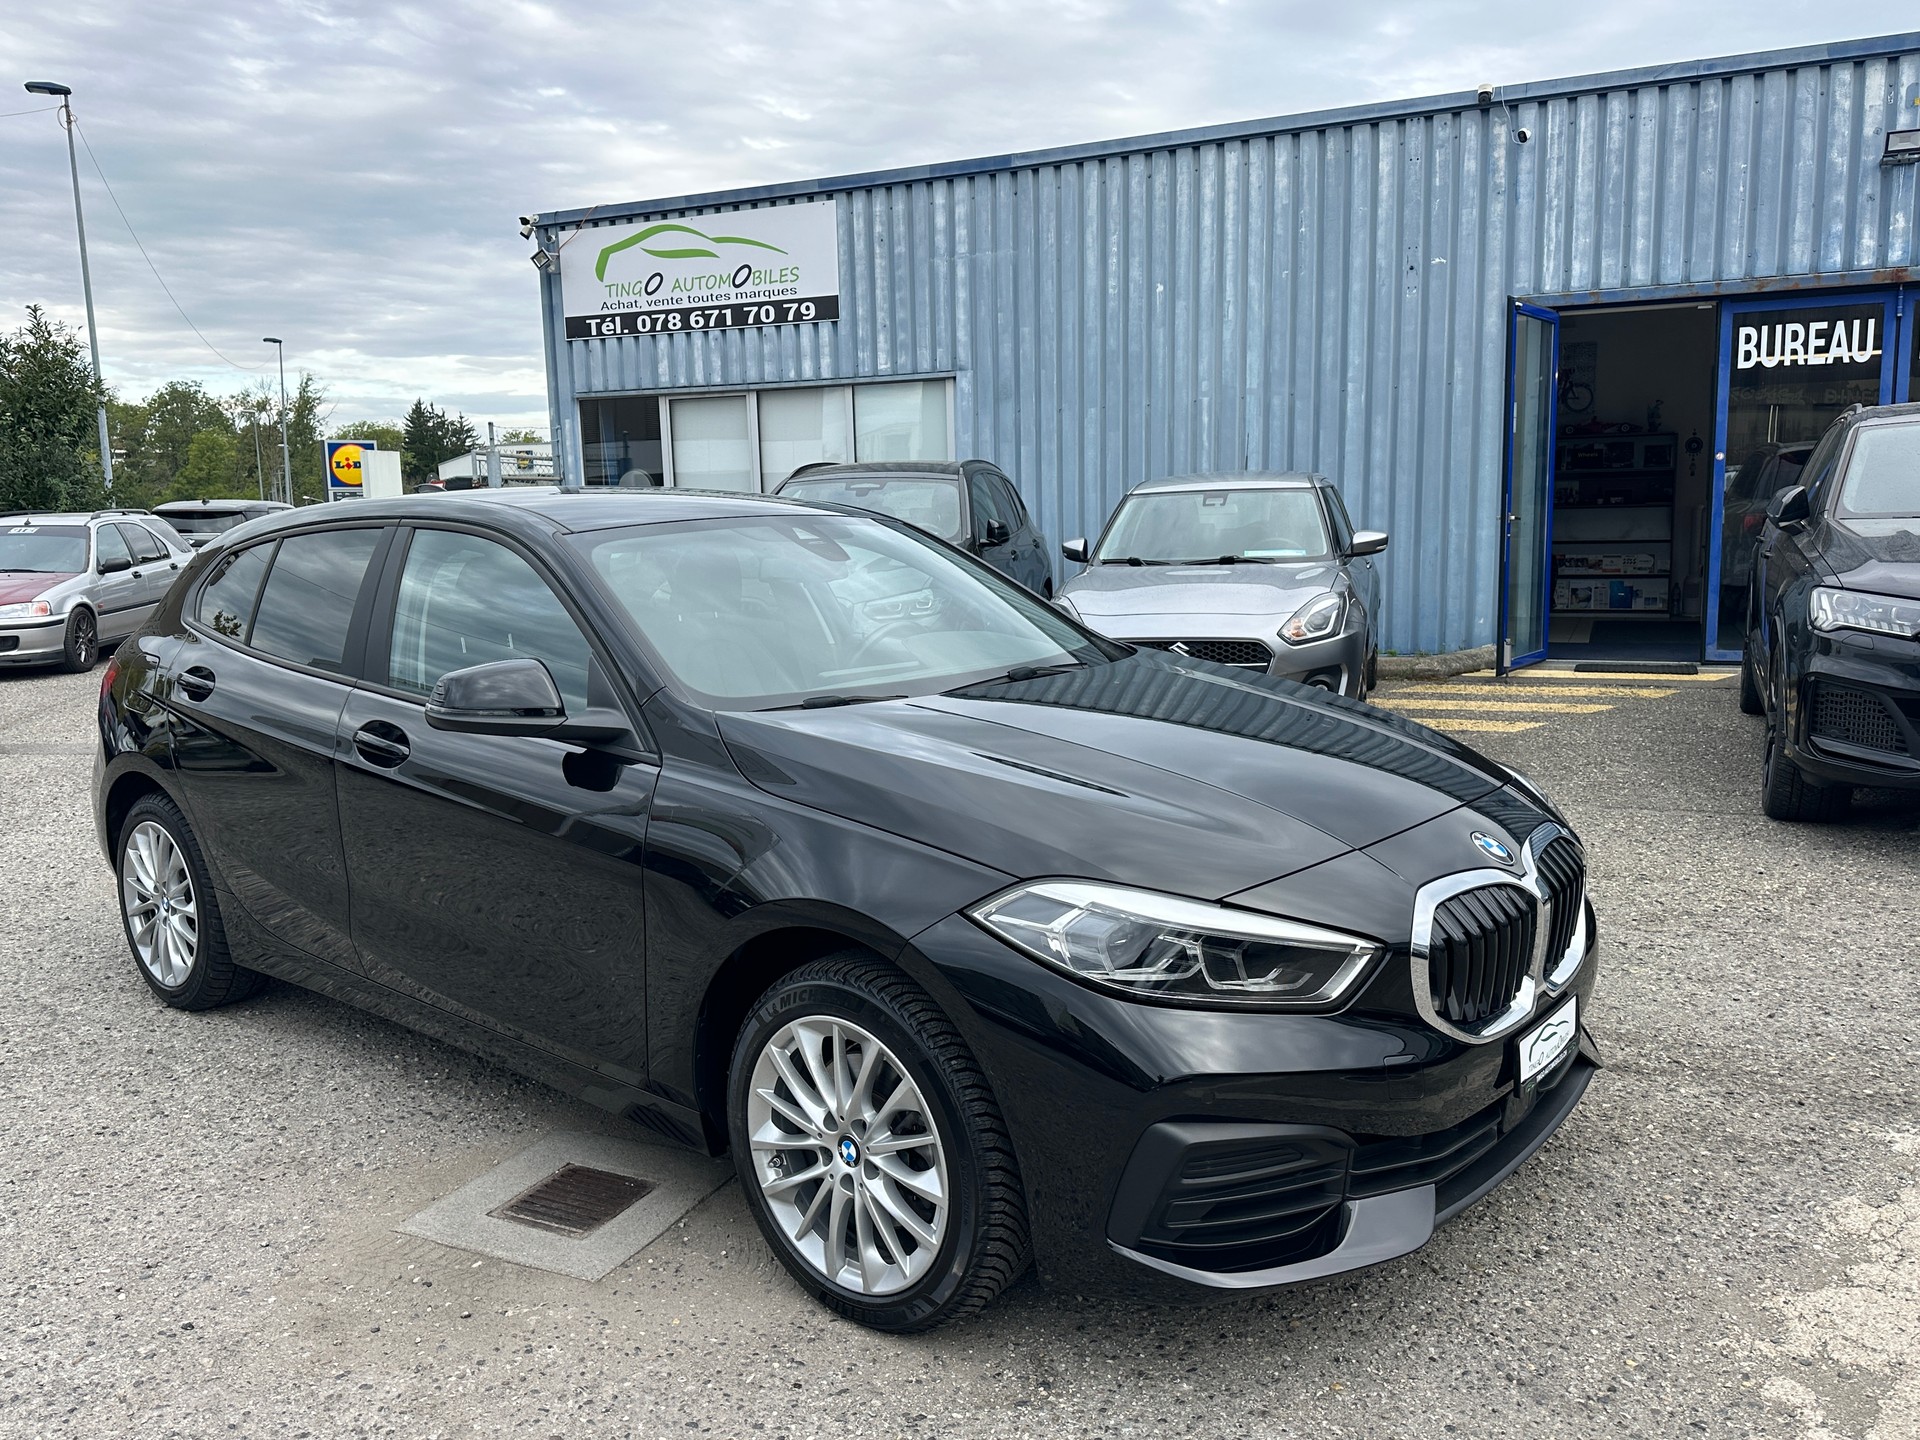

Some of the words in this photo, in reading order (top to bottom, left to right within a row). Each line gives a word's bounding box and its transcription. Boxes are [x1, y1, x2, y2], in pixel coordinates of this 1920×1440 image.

[605, 272, 663, 297] TINGO
[671, 264, 799, 292] AUTOMOBILES
[601, 300, 643, 311] Achat,
[646, 297, 683, 307] vente
[687, 291, 731, 304] toutes
[735, 286, 797, 301] marques
[586, 317, 629, 336] Tél.
[637, 313, 682, 332] 078
[689, 308, 732, 328] 671
[743, 305, 775, 323] 70
[783, 301, 816, 321] 79
[1737, 318, 1876, 369] BUREAU
